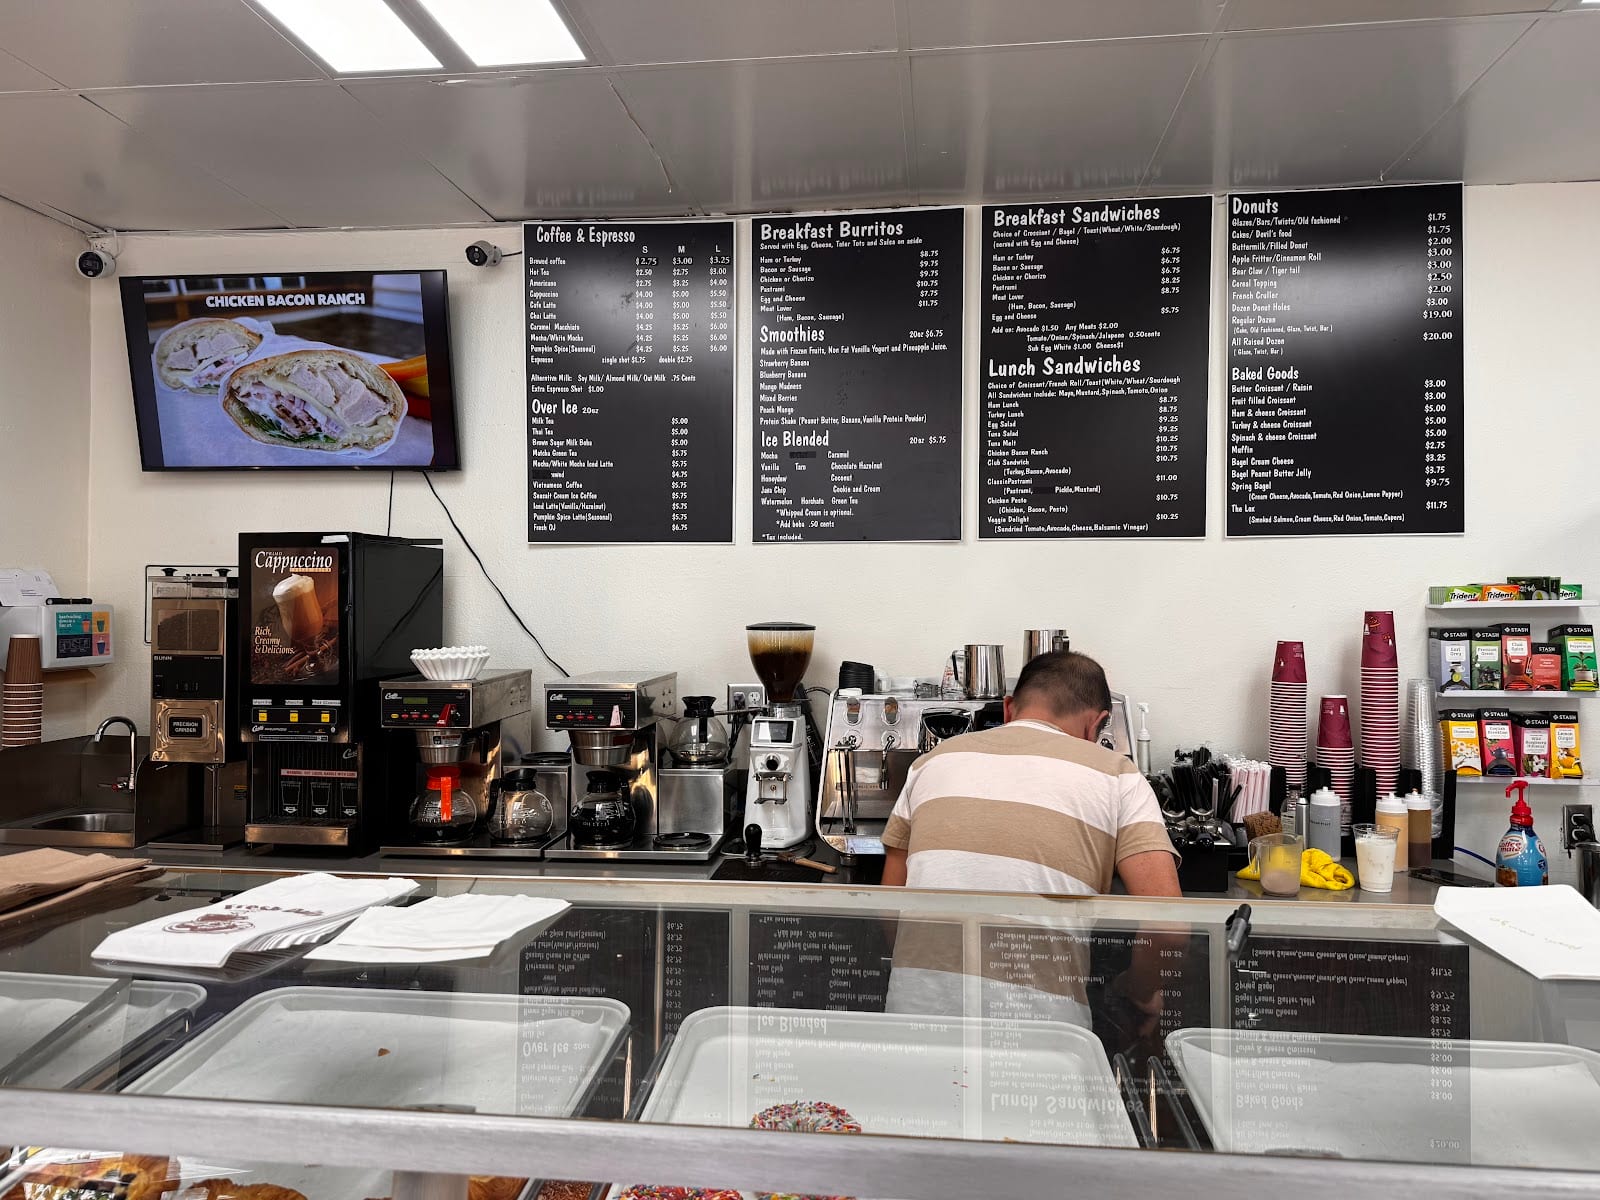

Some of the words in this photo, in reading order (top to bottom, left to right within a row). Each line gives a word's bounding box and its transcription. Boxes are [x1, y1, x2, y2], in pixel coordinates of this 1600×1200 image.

[1232, 197, 1278, 214] Donuts
[994, 209, 1065, 226] Breakfast
[1072, 204, 1160, 223] Sandwiches
[1428, 213, 1446, 221] $1.75
[1311, 216, 1340, 225] fashioned
[760, 223, 833, 240] Breakfast
[840, 221, 903, 238] Burritos
[1428, 225, 1450, 234] $1.75
[536, 227, 571, 243] Coffee
[577, 229, 585, 242] &
[589, 228, 635, 247] Espresso
[1232, 230, 1253, 239] Cakes/
[1256, 230, 1276, 238] Devil's
[1232, 242, 1288, 251] Buttermilk/Filled
[1290, 241, 1308, 249] Donut
[1428, 237, 1452, 246] $2.00
[920, 250, 939, 258] $8.75
[1161, 247, 1180, 255] $6.75
[1427, 248, 1452, 257] $3.00
[550, 257, 566, 265] coffee
[673, 257, 693, 265] $3.00
[710, 256, 730, 264] $3.25
[1016, 253, 1034, 262] Turkey
[1232, 255, 1250, 265] Apple
[1309, 253, 1321, 262] Roll
[920, 260, 939, 268] $9.75
[1427, 272, 1452, 281] $2.50
[916, 280, 938, 288] $10.75
[206, 295, 264, 307] CHICKEN
[267, 294, 315, 307] BACON
[318, 293, 365, 306] RANCH
[1423, 310, 1452, 319] $19.00
[760, 325, 824, 342] Smoothies
[925, 330, 943, 338] $6.75
[1423, 332, 1452, 341] $20.00
[989, 358, 1035, 377] Lunch
[1043, 355, 1141, 376] Sandwiches
[1232, 366, 1262, 380] Baked
[1267, 366, 1299, 380] Goods
[1424, 379, 1446, 388] $3.00
[1232, 385, 1251, 393] Butter
[1255, 384, 1283, 392] Croissant
[1286, 384, 1290, 392] /
[1293, 384, 1312, 392] Raisin
[1159, 396, 1177, 404] $8.75
[532, 399, 557, 414] Over
[562, 399, 578, 414] Ice
[1158, 415, 1178, 423] $9.25
[988, 421, 998, 429] Egg
[671, 428, 688, 436] $5.00
[761, 431, 778, 447] Ice
[783, 430, 829, 446] Blended
[929, 436, 946, 444] $5.75
[1156, 435, 1178, 443] $10.25
[1232, 446, 1253, 454] Muffin
[1425, 441, 1445, 450] $2.75
[1232, 470, 1249, 479] Bagel
[1274, 469, 1294, 477] Butter
[1296, 469, 1311, 478] Jelly
[1425, 466, 1445, 474] $3.75
[1156, 474, 1177, 482] $11.00
[1425, 478, 1450, 487] $9.75
[1232, 483, 1252, 492] Spring
[1254, 482, 1272, 491] Bagel
[1426, 501, 1448, 510] $11.75
[256, 551, 332, 573] Cappuccino
[255, 627, 272, 636] Rich,
[255, 636, 280, 646] Creamy
